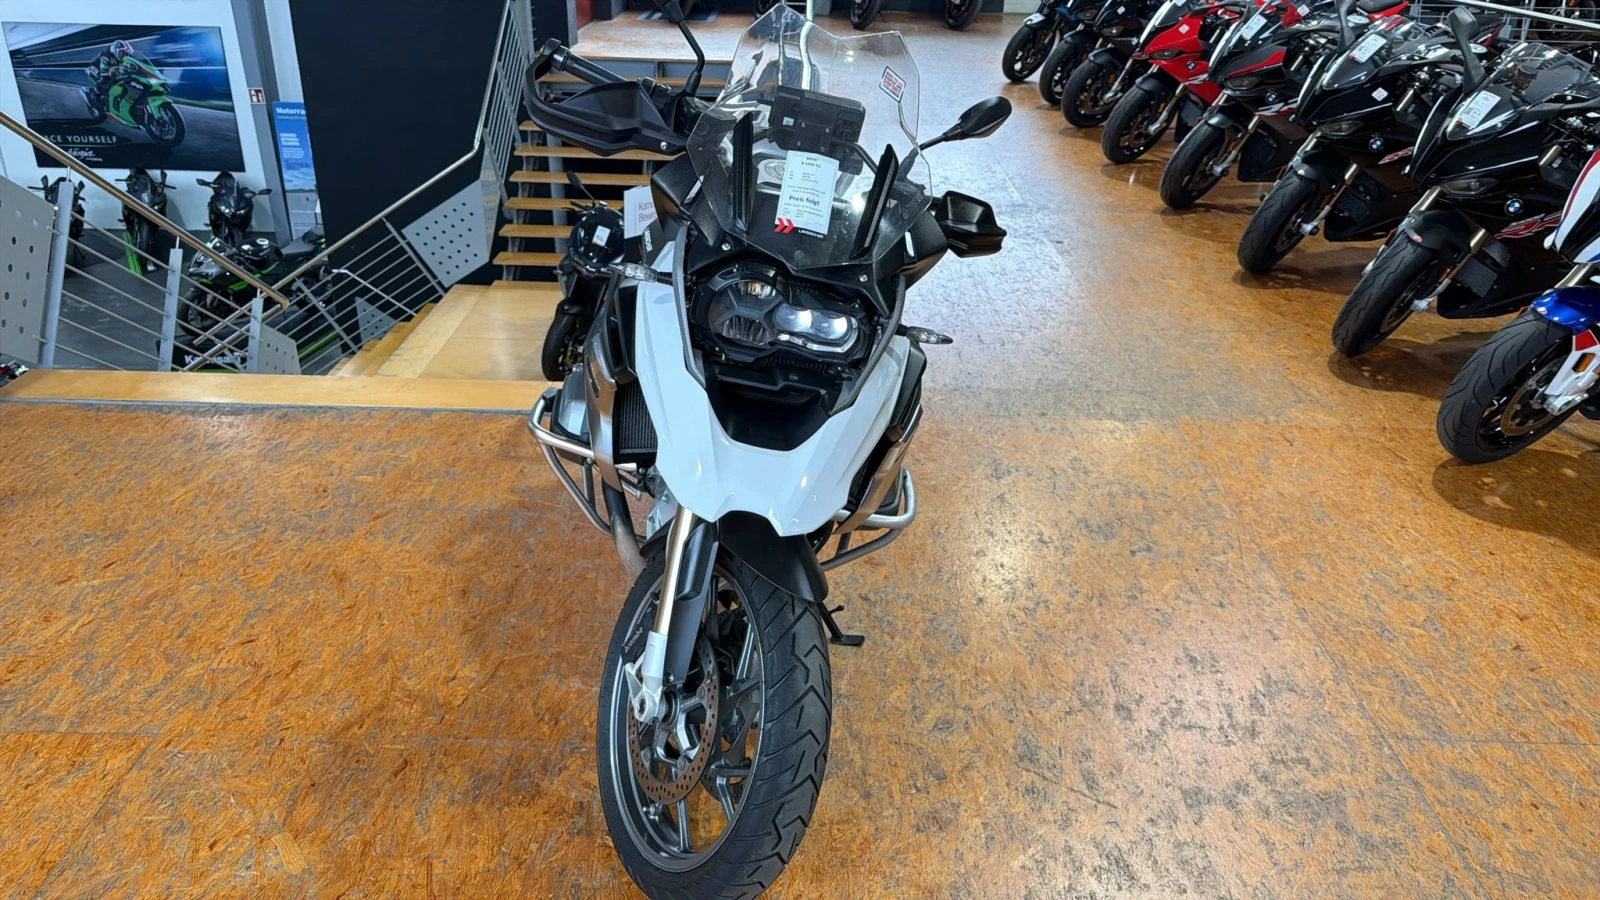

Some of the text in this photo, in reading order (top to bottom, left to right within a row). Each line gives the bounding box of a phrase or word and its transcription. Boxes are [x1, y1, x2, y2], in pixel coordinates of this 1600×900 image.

[275, 107, 307, 115] Motorra
[66, 135, 118, 144] YOURSELF
[789, 194, 820, 207] Preis folgt
